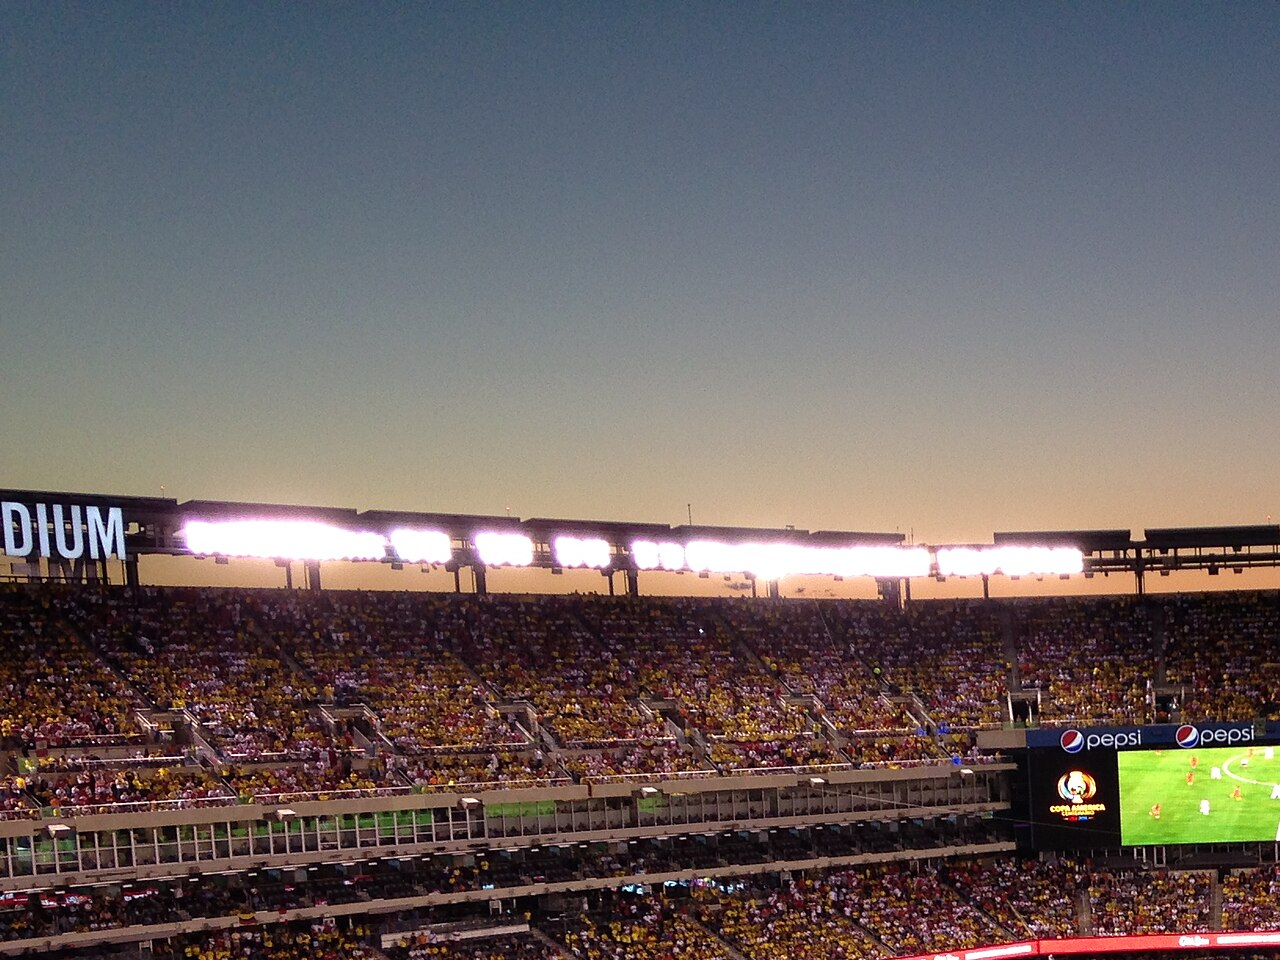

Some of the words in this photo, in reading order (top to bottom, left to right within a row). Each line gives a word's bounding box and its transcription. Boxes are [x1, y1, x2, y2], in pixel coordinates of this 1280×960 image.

[1, 501, 126, 560] DIUM
[1087, 730, 1142, 750] pepsi
[1200, 725, 1255, 746] pepsi
